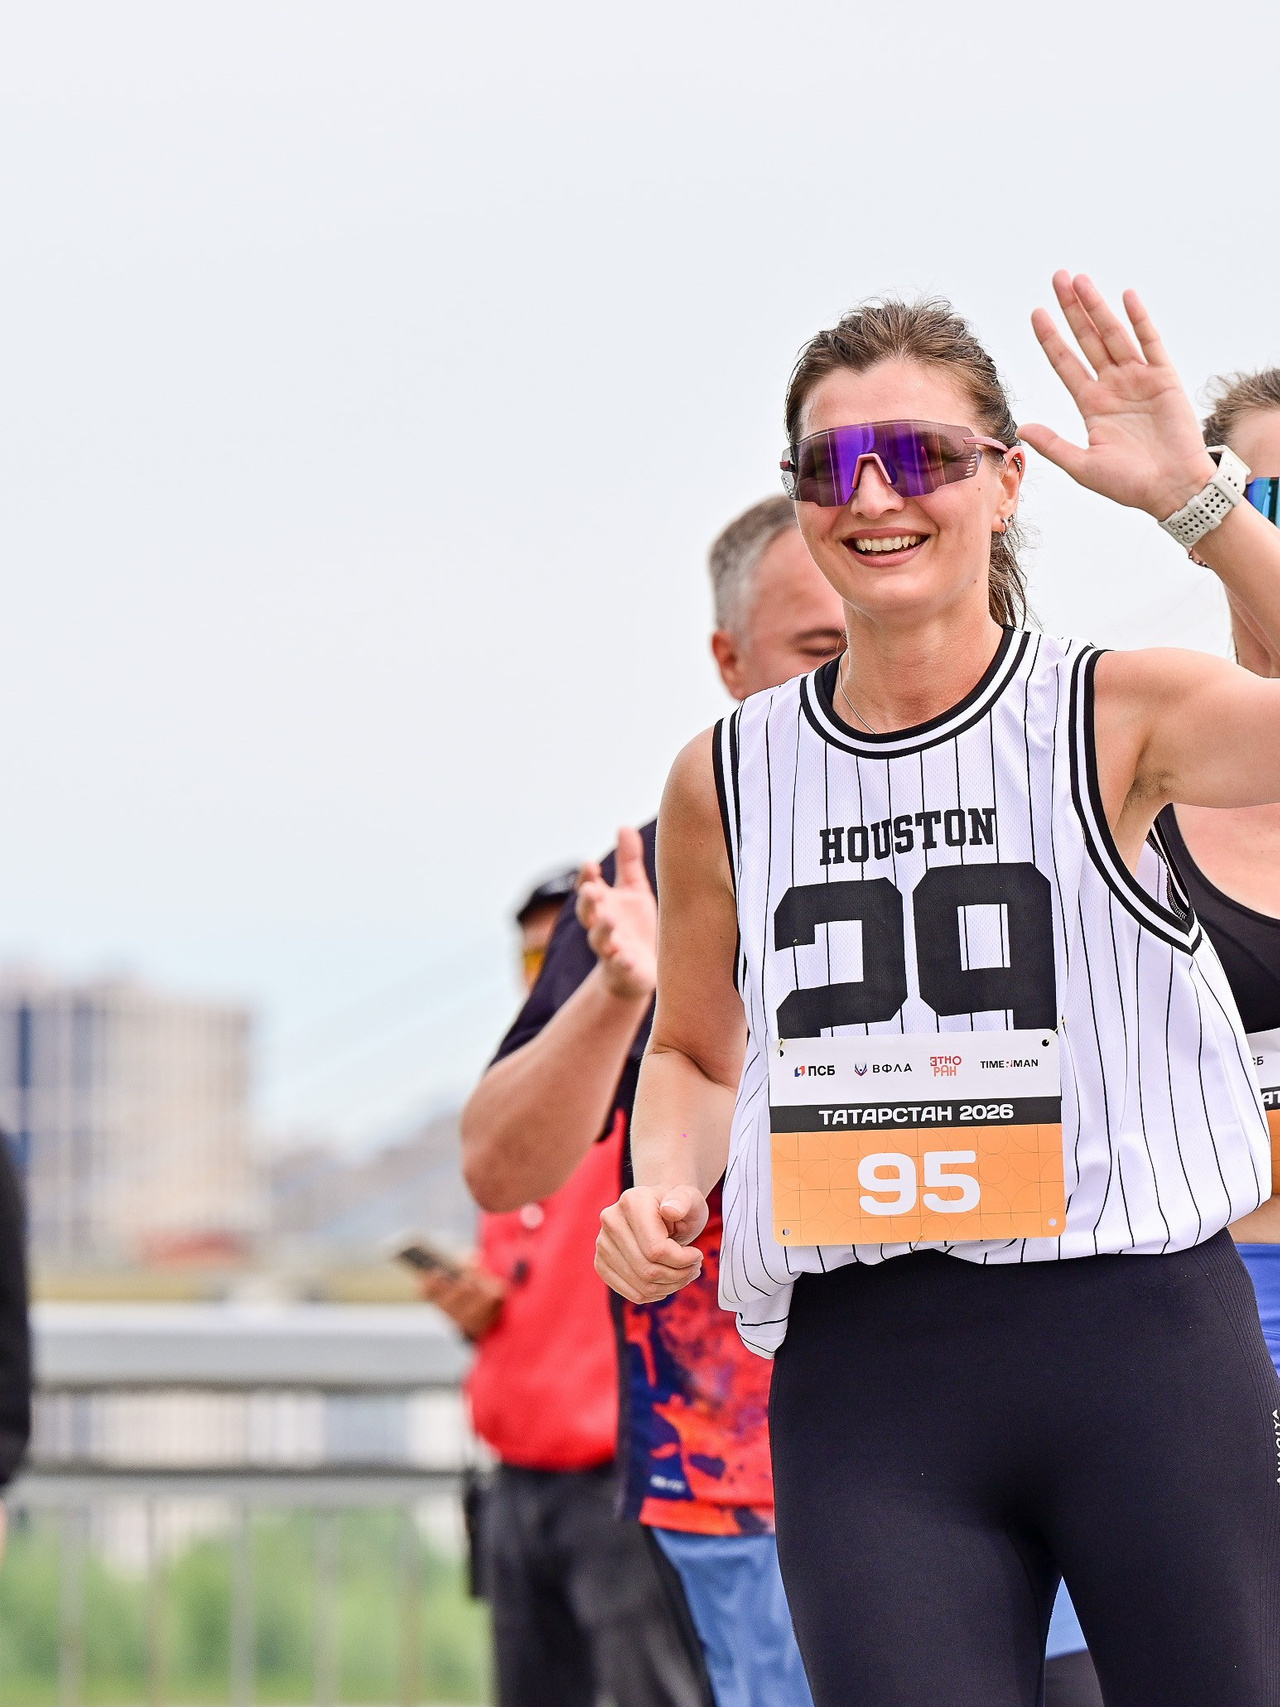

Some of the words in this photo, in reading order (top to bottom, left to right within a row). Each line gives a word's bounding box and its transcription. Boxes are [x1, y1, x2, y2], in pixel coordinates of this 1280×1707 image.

[819, 808, 996, 866] HOUSTON
[774, 861, 1057, 1039] 29
[808, 1065, 835, 1076] ПСБ
[872, 1063, 912, 1073] ВФЛА
[818, 1106, 952, 1125] ТАТАРСТАН
[959, 1104, 1014, 1120] 2026
[857, 1150, 981, 1216] 95
